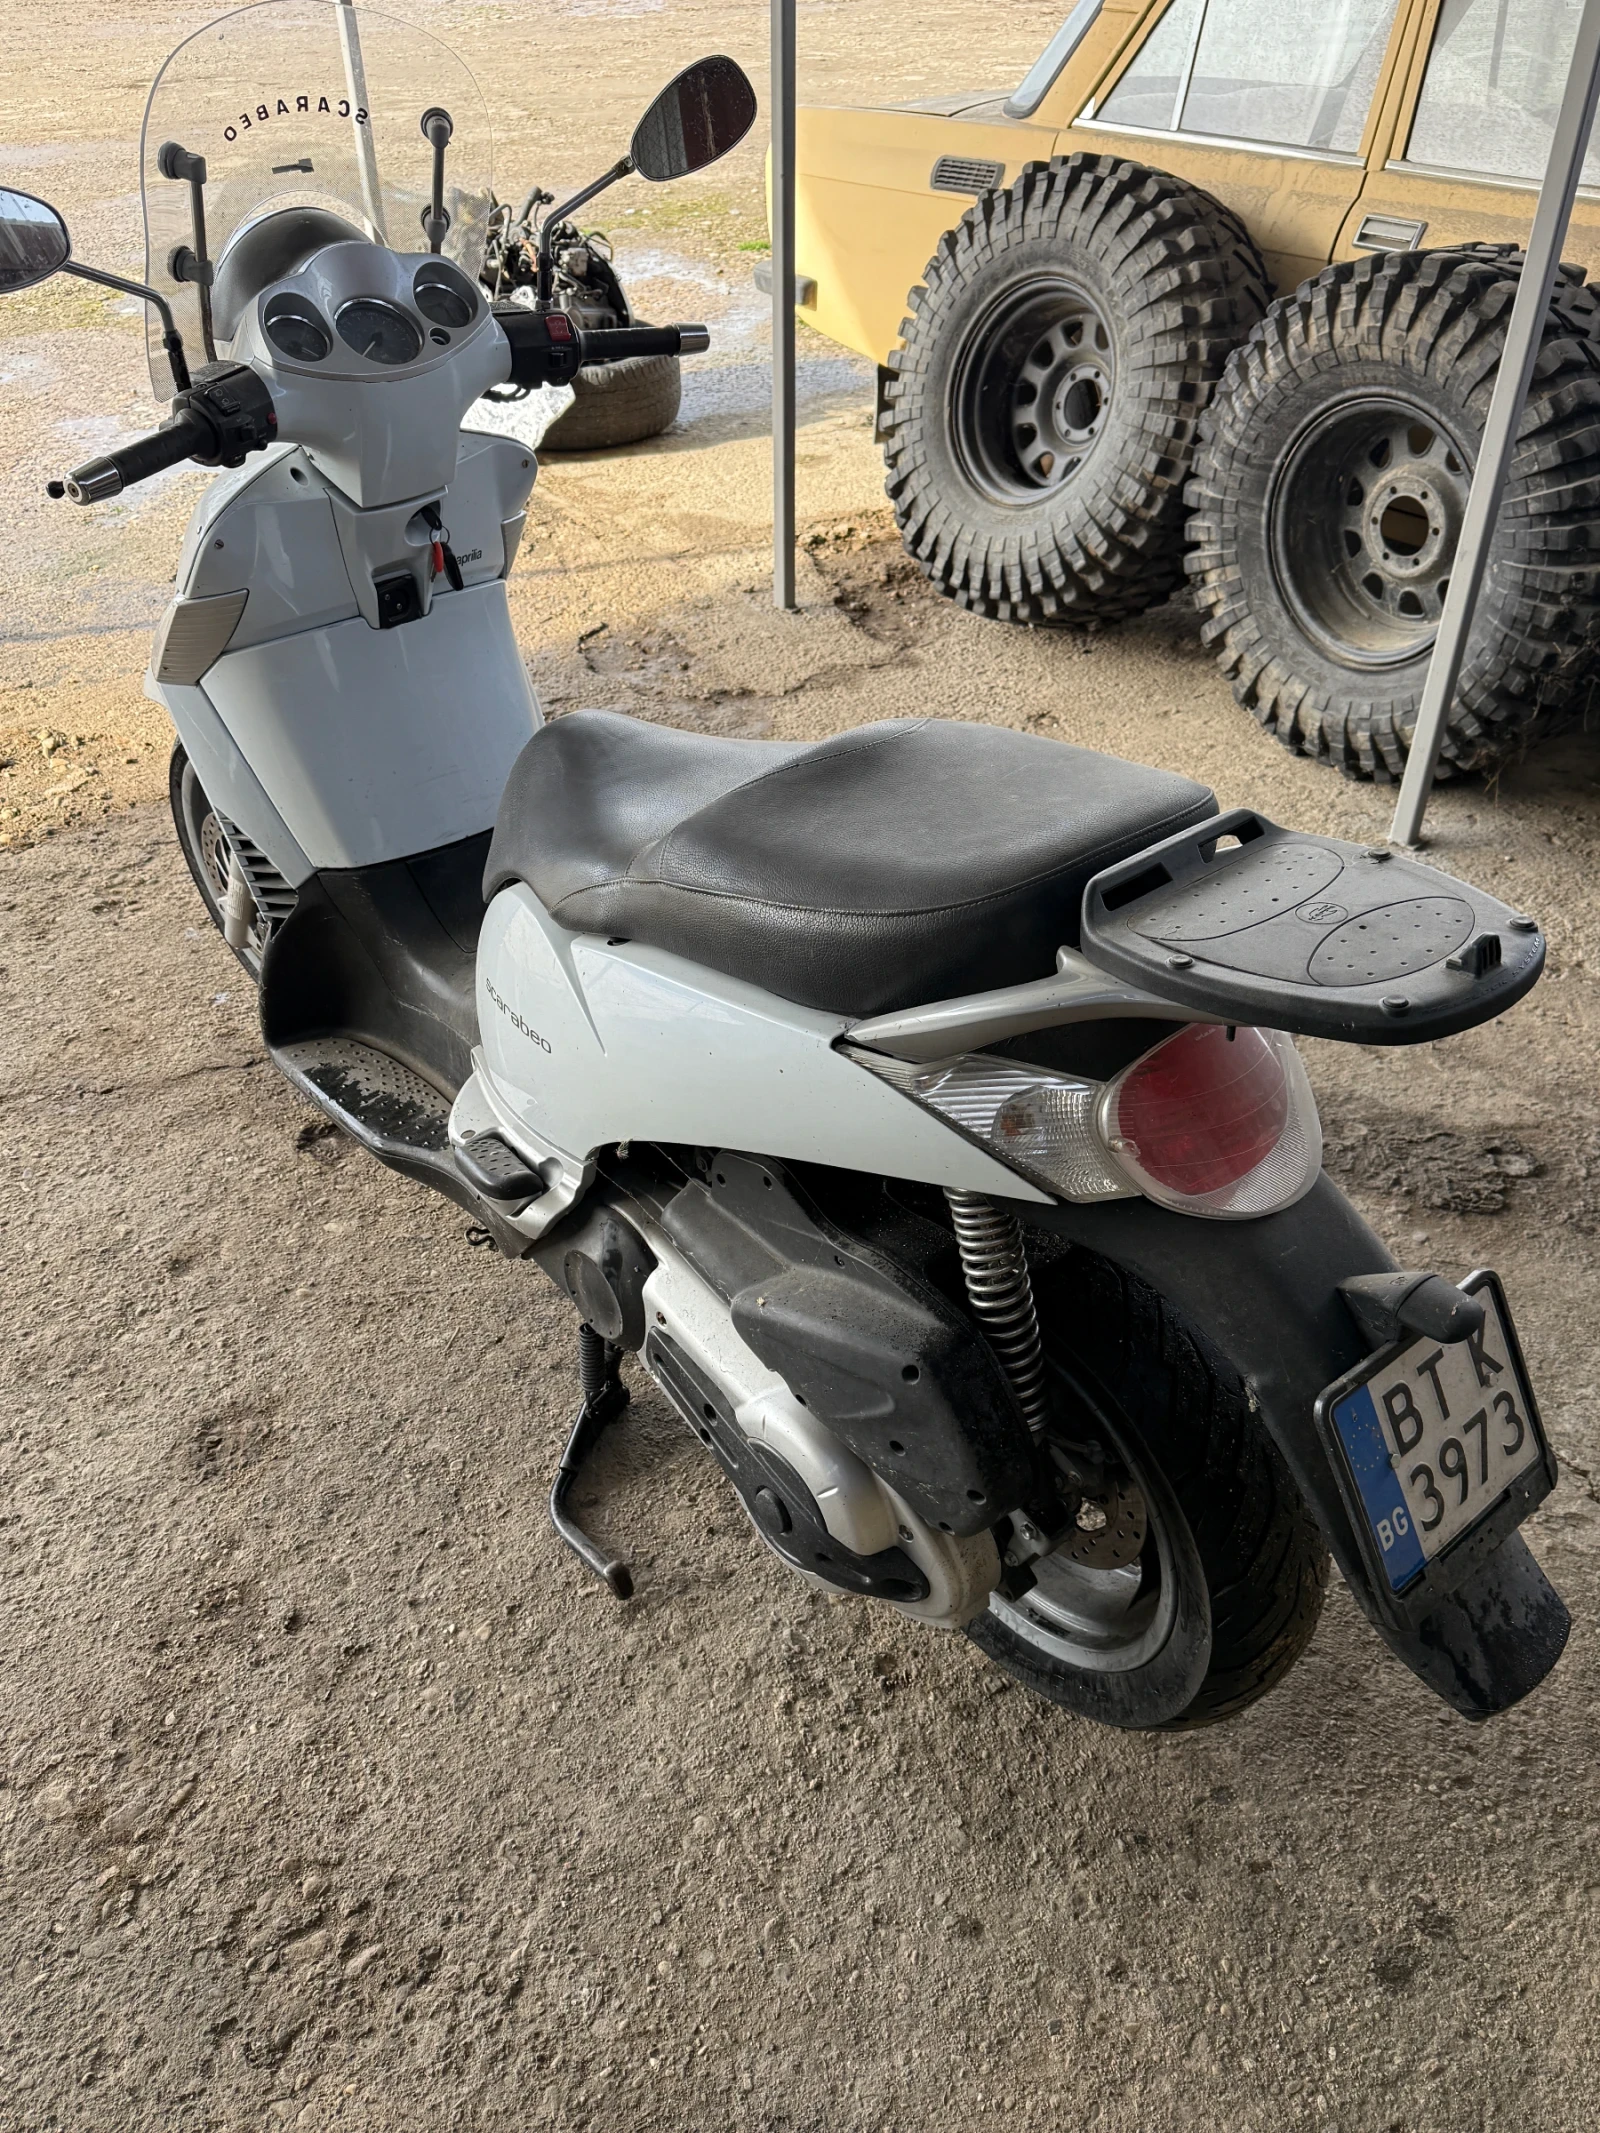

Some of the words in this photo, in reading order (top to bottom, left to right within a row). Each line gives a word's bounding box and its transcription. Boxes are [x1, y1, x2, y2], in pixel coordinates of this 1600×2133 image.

[456, 548, 482, 567] aprilia
[486, 978, 552, 1054] scarabeo
[1409, 1390, 1525, 1532] 3973
[1376, 1506, 1409, 1552] BG
